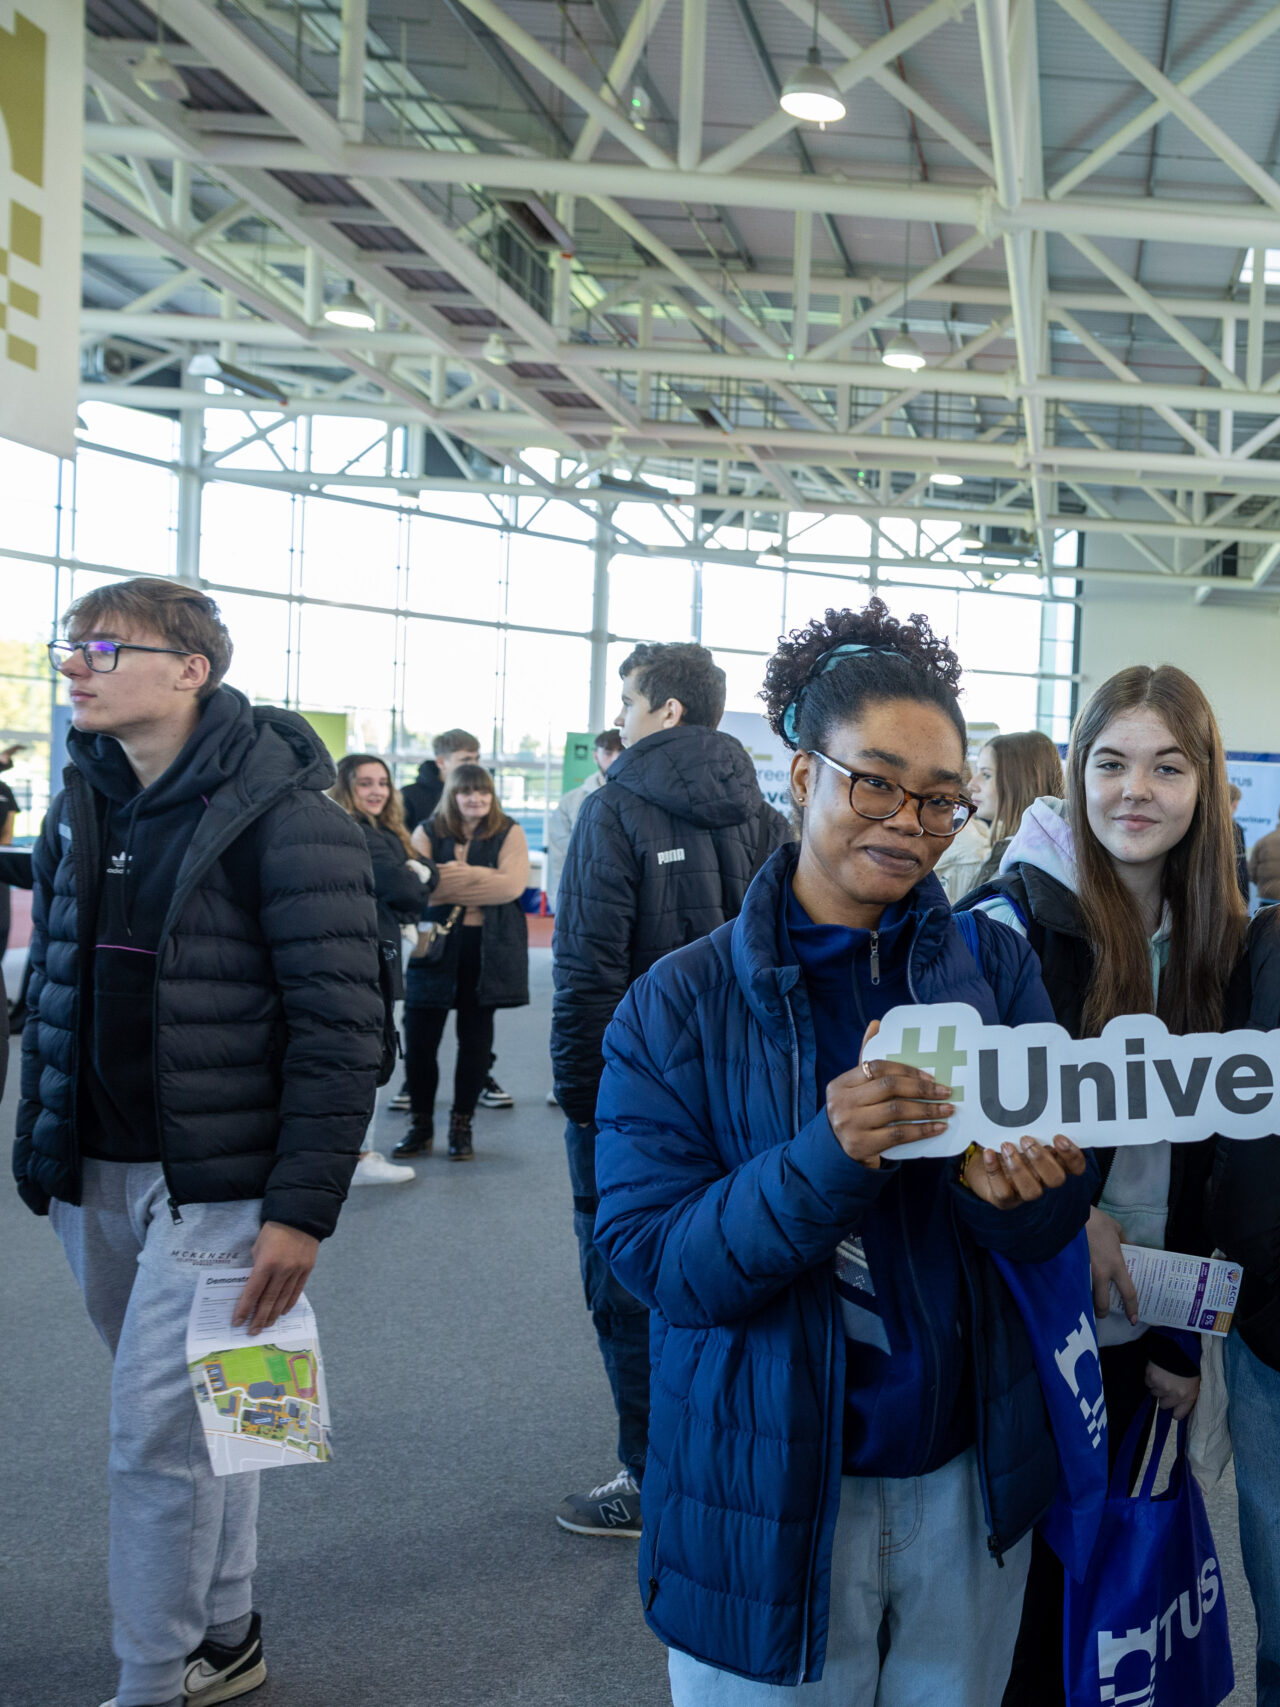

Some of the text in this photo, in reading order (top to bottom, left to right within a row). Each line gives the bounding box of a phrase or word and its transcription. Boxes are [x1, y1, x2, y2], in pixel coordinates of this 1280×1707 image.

[657, 848, 686, 865] PUMA
[170, 1250, 239, 1259] MCKENZIE
[1228, 1285, 1238, 1307] ACCU
[1159, 1557, 1219, 1662] TUS
